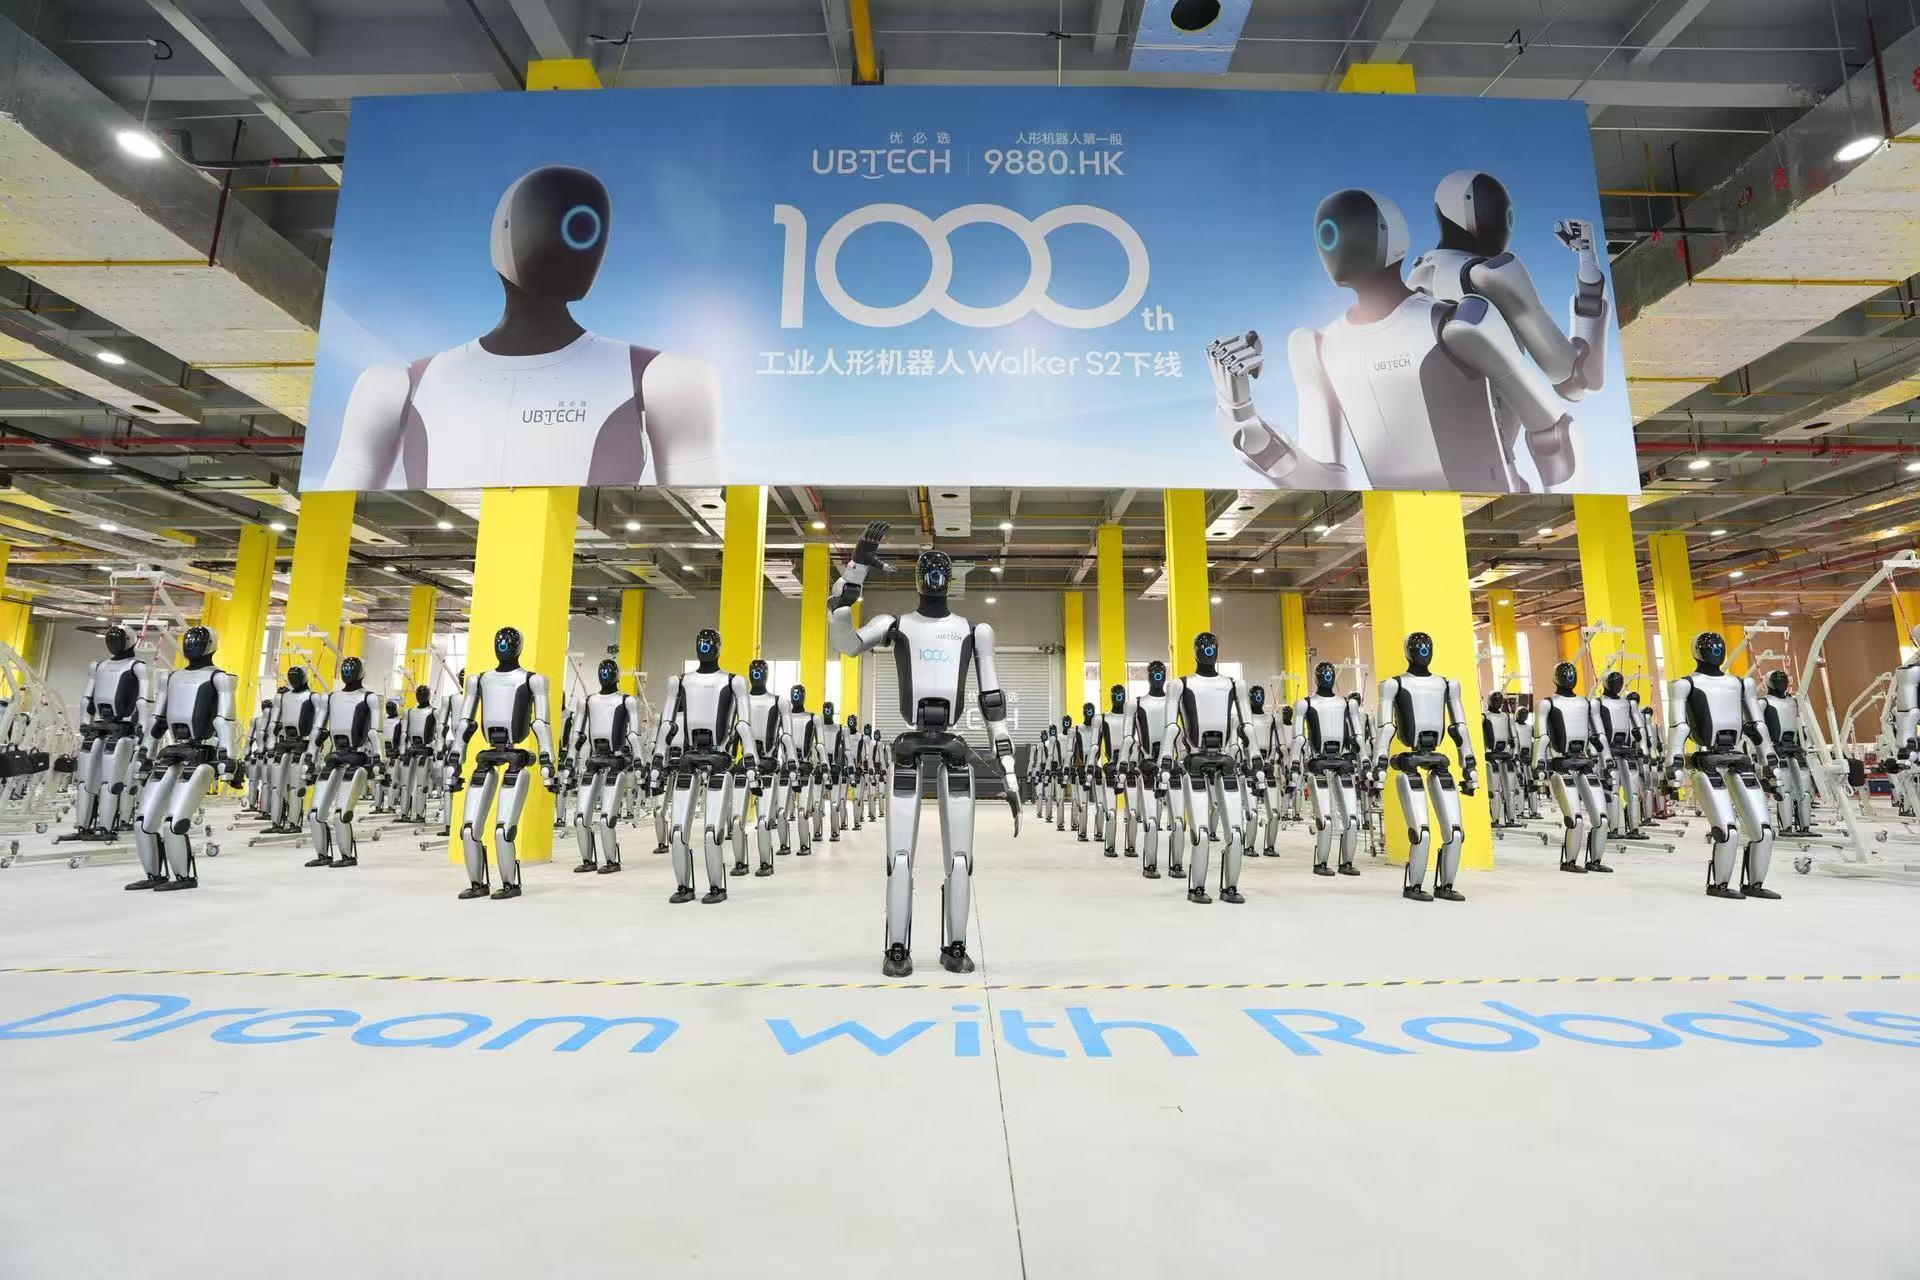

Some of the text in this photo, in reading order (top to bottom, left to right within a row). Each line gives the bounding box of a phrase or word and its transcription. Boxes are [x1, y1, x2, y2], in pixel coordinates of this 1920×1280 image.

[889, 131, 951, 144] 优必选
[1015, 131, 1123, 146] 人形机器人第一股
[812, 149, 951, 176] UBTECH
[984, 149, 1125, 175] 9880.HK
[1373, 358, 1411, 371] UBTECH
[522, 409, 586, 424] UBTECH
[0, 994, 679, 1052] Dream
[768, 1004, 1196, 1058] with
